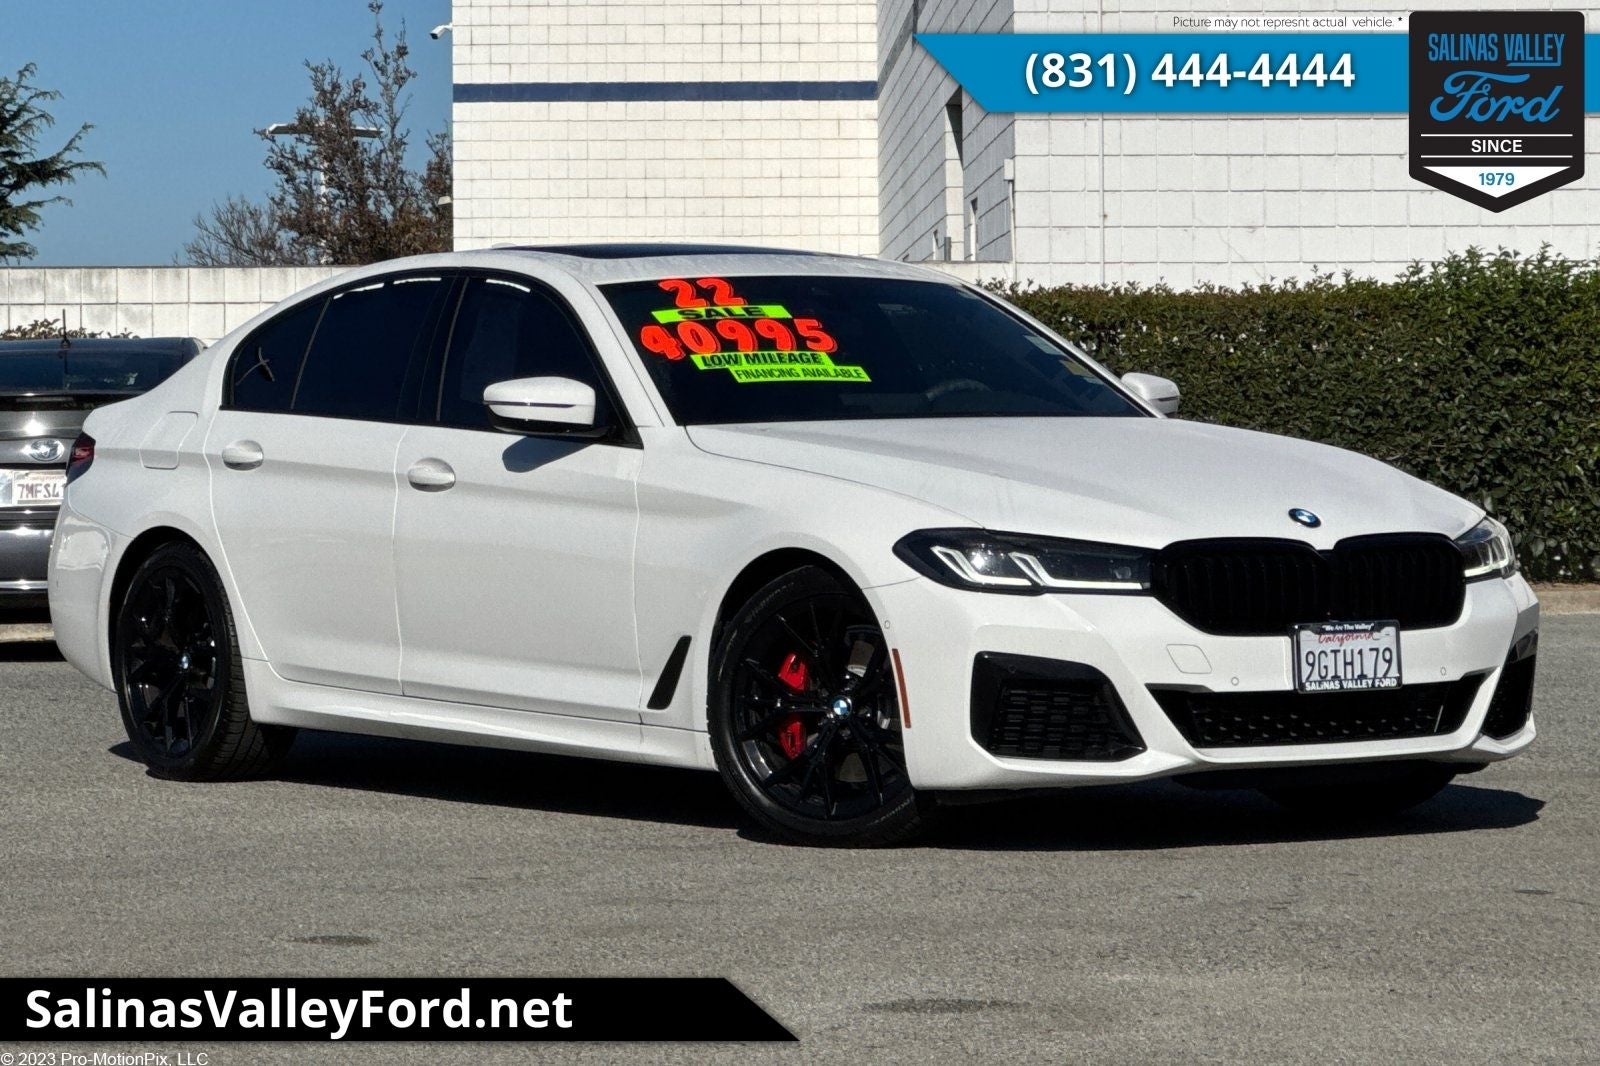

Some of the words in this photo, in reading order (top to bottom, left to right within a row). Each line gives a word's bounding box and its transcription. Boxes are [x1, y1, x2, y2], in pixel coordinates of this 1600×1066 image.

[657, 278, 748, 308] 22
[677, 306, 767, 320] SALE
[640, 318, 838, 360] 40995
[701, 353, 743, 368] LOW
[744, 351, 823, 367] MILEAGE
[735, 366, 800, 380] FINANCING
[800, 364, 867, 380] AVAILABLE
[1344, 623, 1354, 631] The
[1305, 647, 1393, 680] 9GIH179
[1342, 679, 1373, 689] VALLEY
[1374, 678, 1398, 688] FORD
